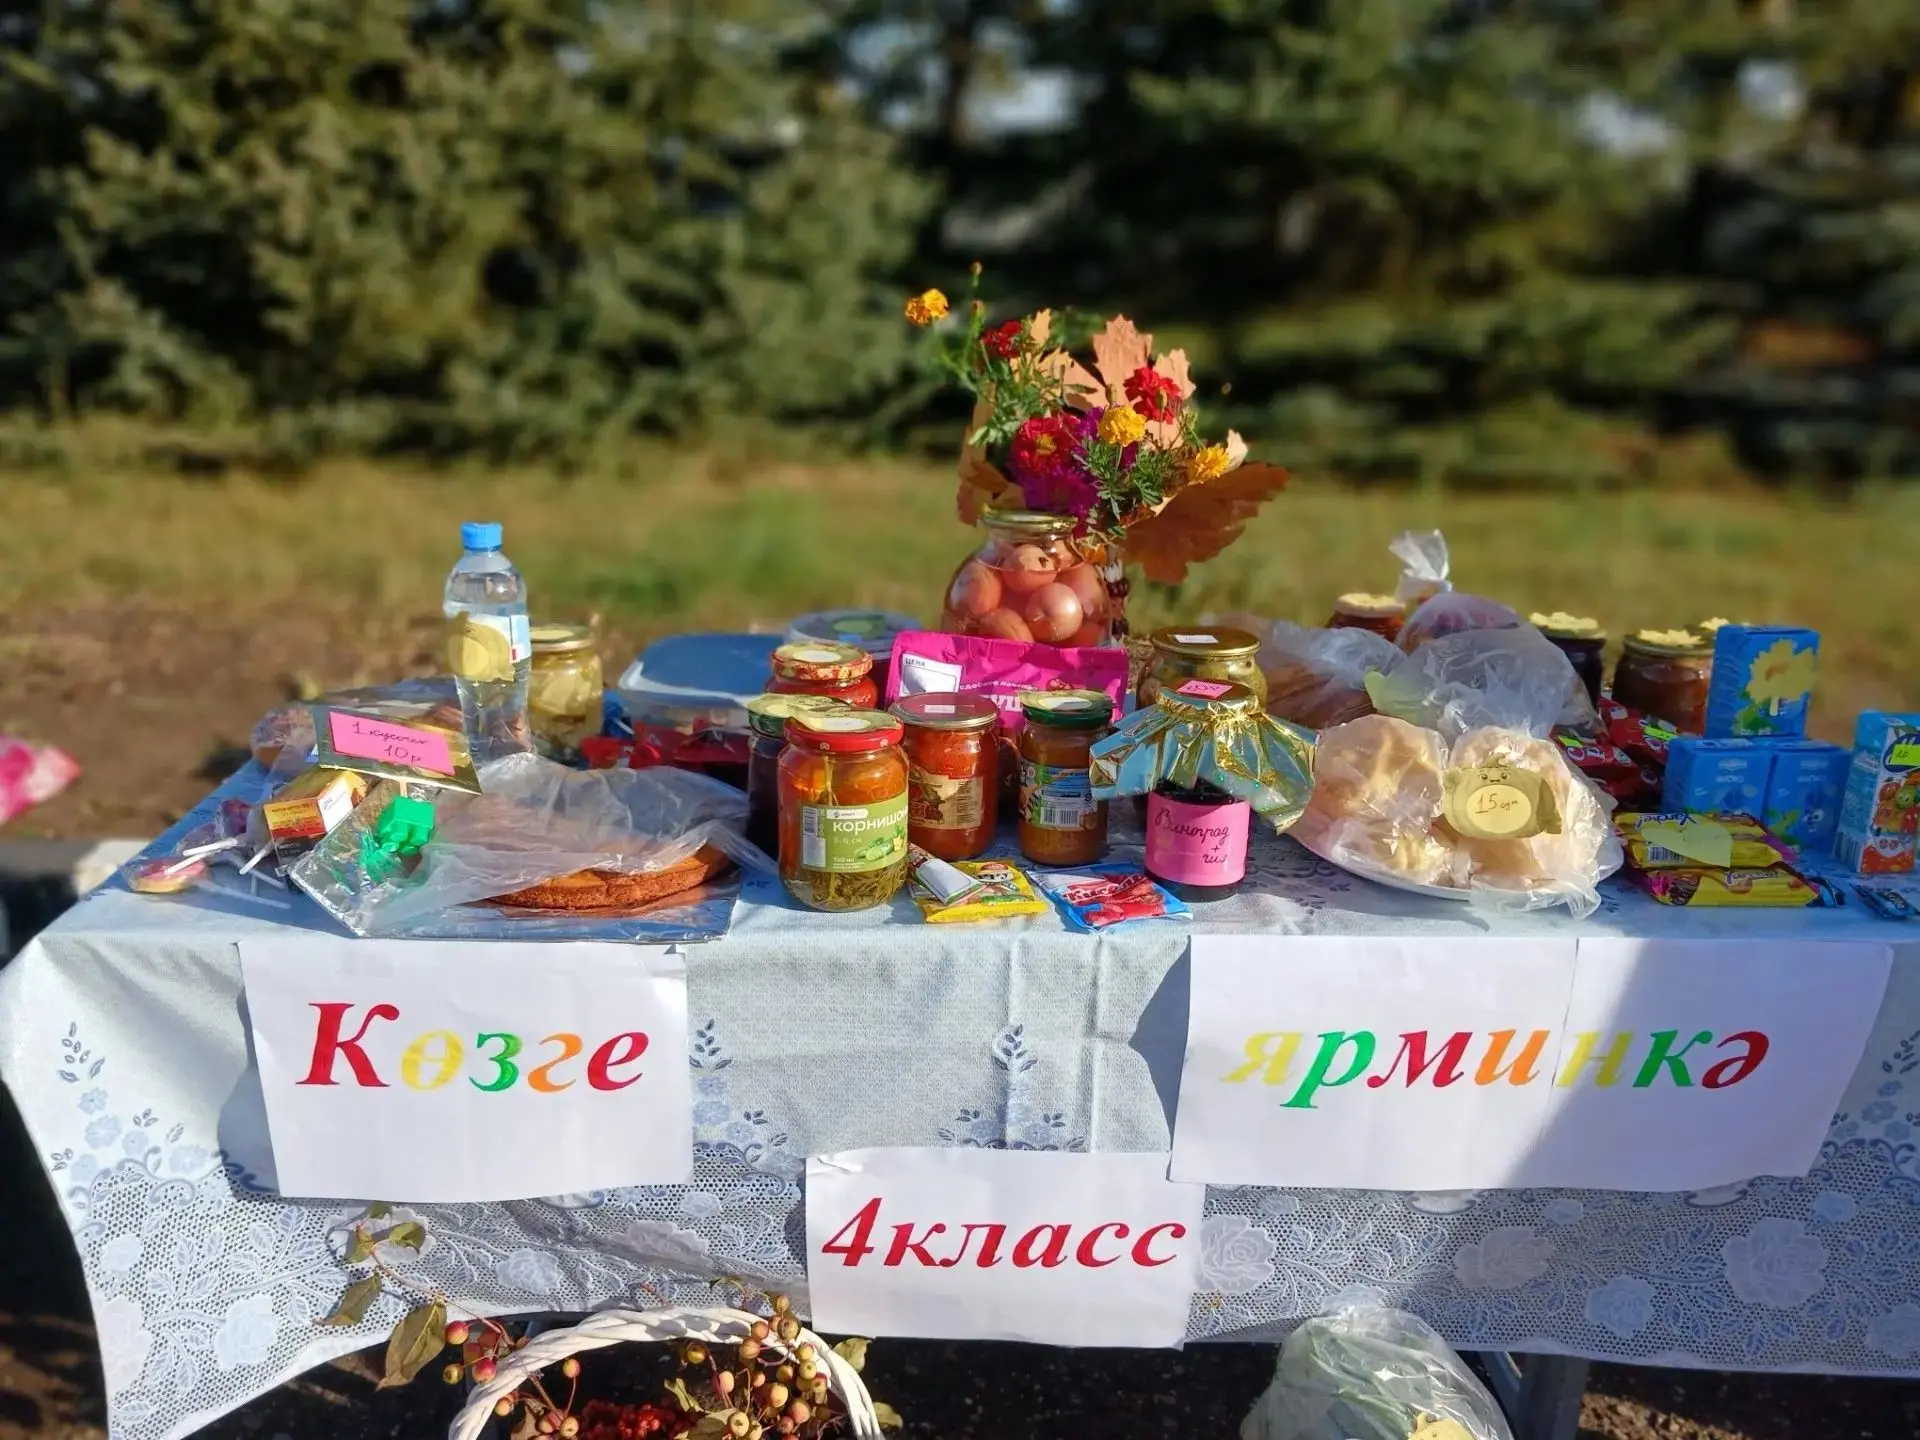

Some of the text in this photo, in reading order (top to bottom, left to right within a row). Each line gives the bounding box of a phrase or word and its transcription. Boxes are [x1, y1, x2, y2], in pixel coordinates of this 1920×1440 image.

[905, 658, 926, 668] ЦЕНА
[1154, 806, 1230, 846] Виноград
[295, 1001, 650, 1093] Көзге
[1219, 1028, 1771, 1109] ярминкә
